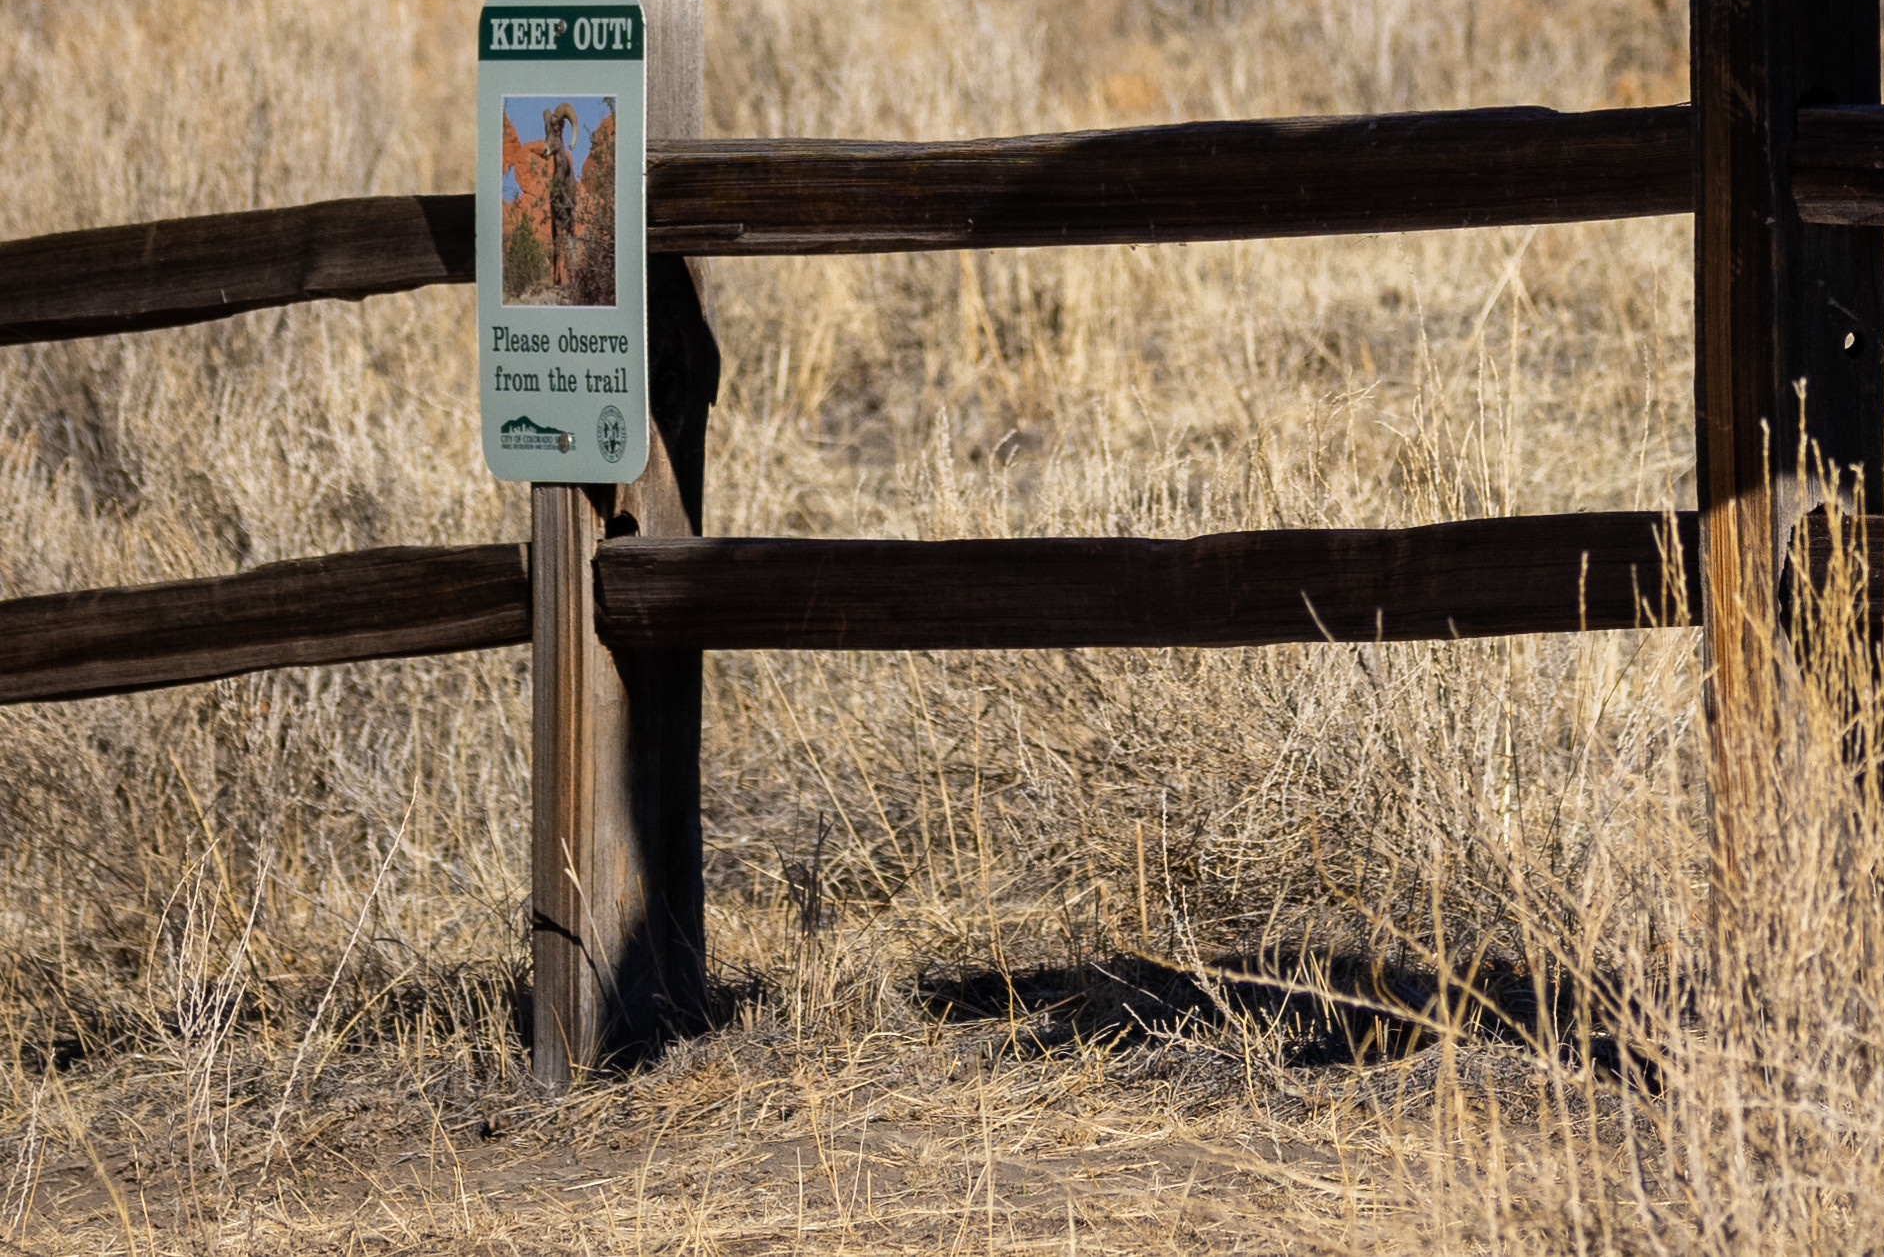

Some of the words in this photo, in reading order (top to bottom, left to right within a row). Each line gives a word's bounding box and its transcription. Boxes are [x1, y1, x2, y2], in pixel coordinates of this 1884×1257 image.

[573, 17, 632, 50] OUT!
[492, 326, 550, 353] Please
[558, 327, 629, 354] observe
[495, 365, 541, 392] from
[548, 367, 577, 393] the
[585, 367, 629, 393] trail
